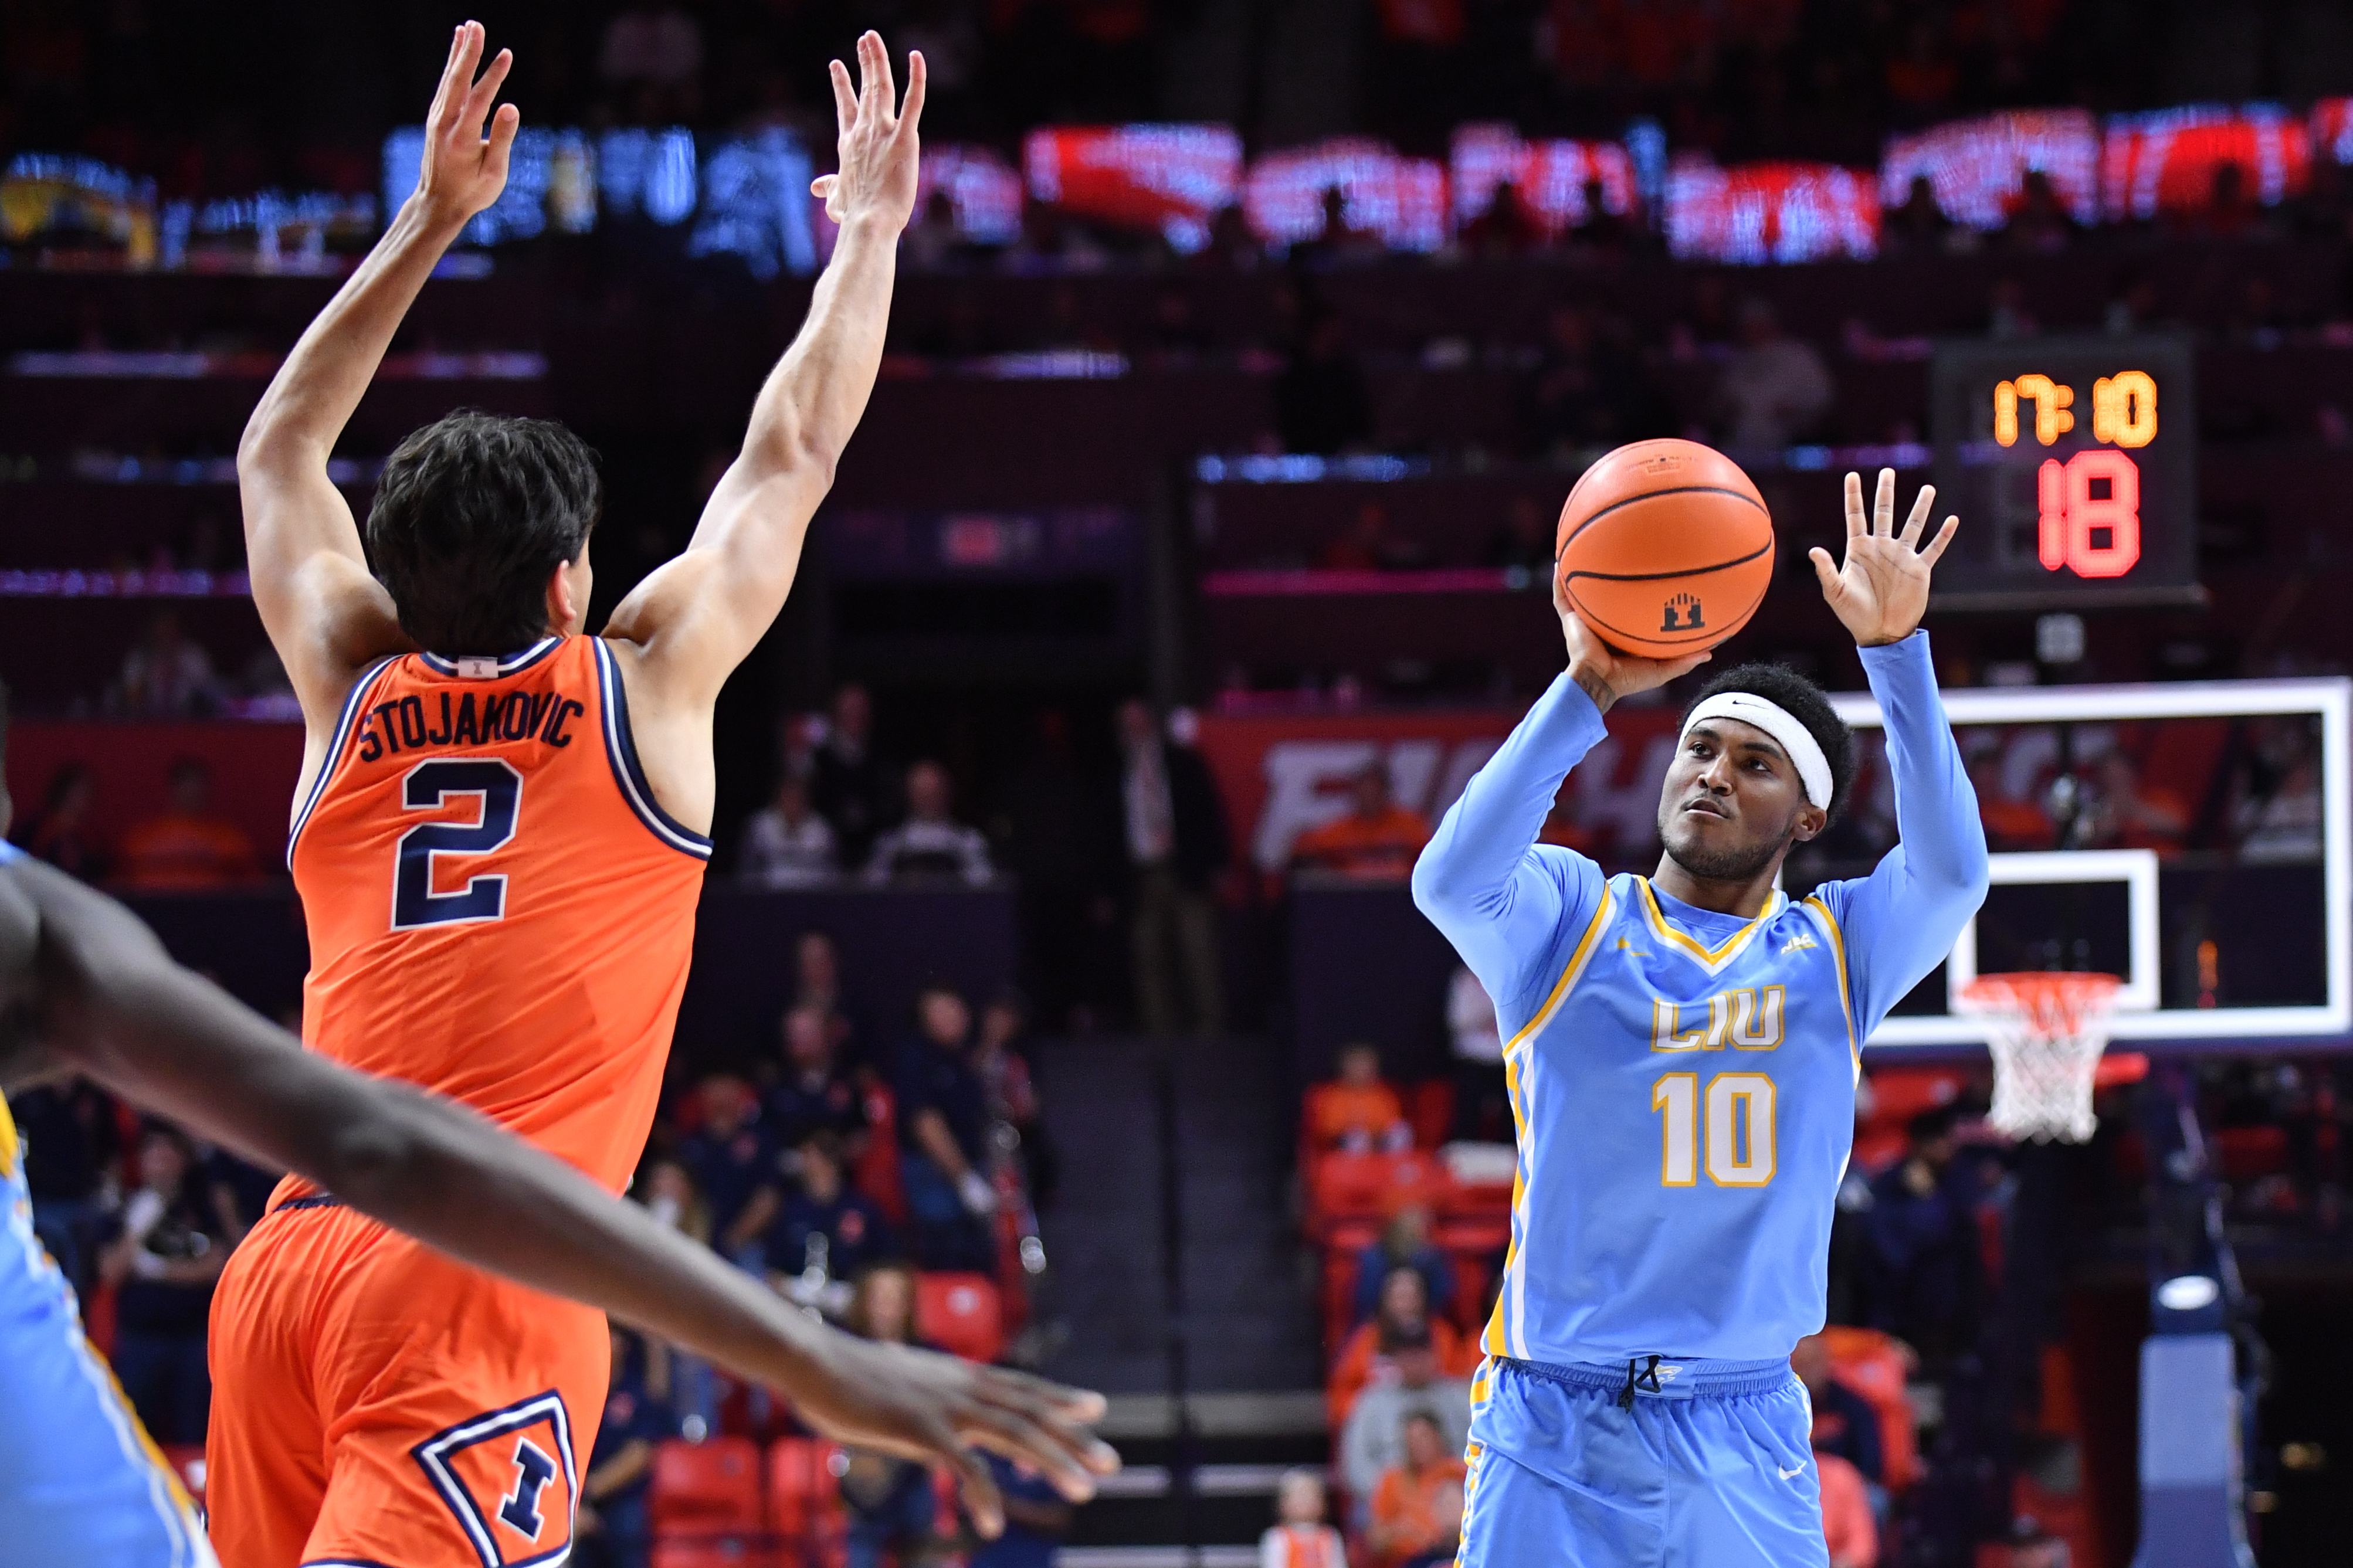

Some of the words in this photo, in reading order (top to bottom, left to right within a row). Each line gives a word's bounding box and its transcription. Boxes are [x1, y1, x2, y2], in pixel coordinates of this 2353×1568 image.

[1995, 371, 2157, 448] 17:10
[2038, 449, 2140, 578] 18
[359, 691, 584, 762] STOJAKOVIC
[391, 757, 524, 931] 2
[1650, 985, 1785, 1052] LIU
[1652, 1072, 1776, 1187] 10
[497, 1436, 557, 1543] I
